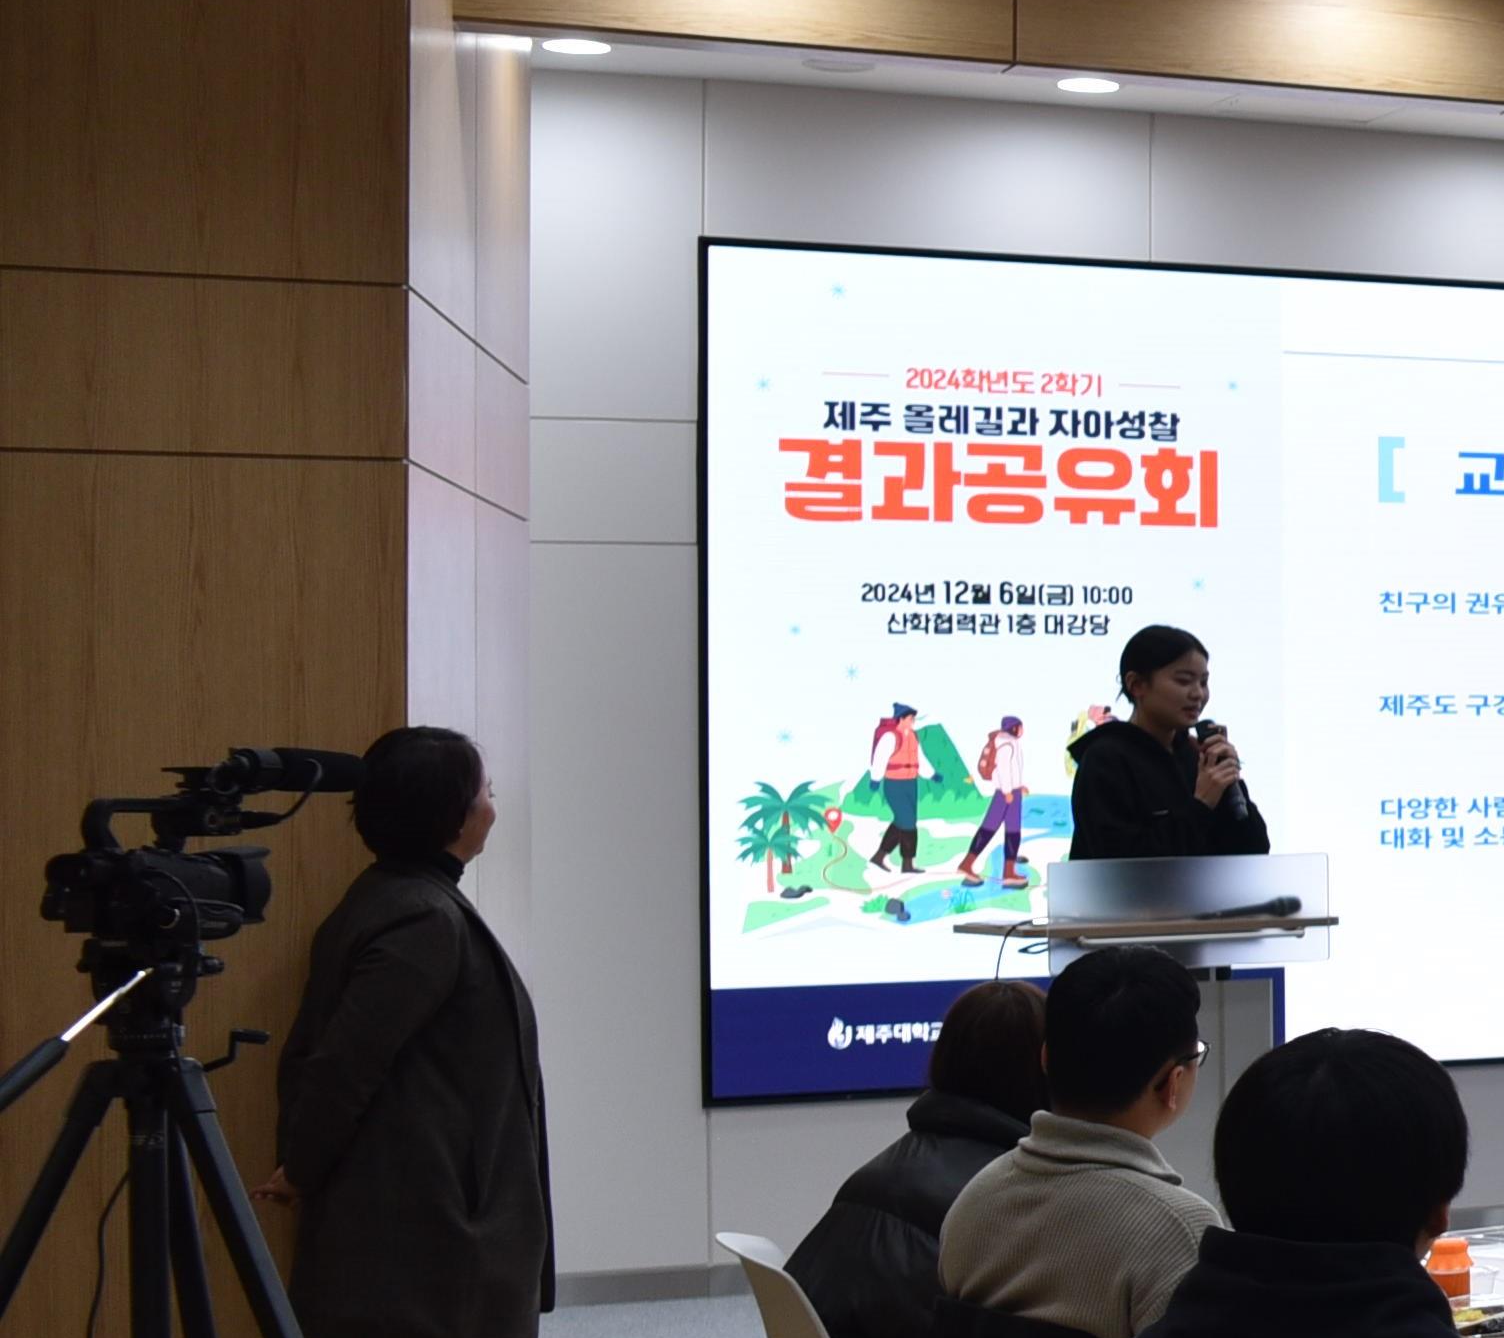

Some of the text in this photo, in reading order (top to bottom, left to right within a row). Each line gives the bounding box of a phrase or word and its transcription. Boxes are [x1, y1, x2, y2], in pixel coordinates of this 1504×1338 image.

[905, 367, 1102, 397] 2024학년도 2학기
[823, 400, 1180, 442] 제주 올레길과 자아성찰
[779, 438, 1218, 528] 결과공유회
[861, 580, 1133, 607] 2024년 12월 6일(금) 10:00
[1379, 591, 1457, 614] 친구의
[887, 612, 1111, 636] 산학협력관 1층 대강당
[1379, 694, 1459, 717] 제주도
[1380, 795, 1460, 820] 다양한
[1380, 826, 1433, 850] 대화
[1441, 826, 1465, 849] 및
